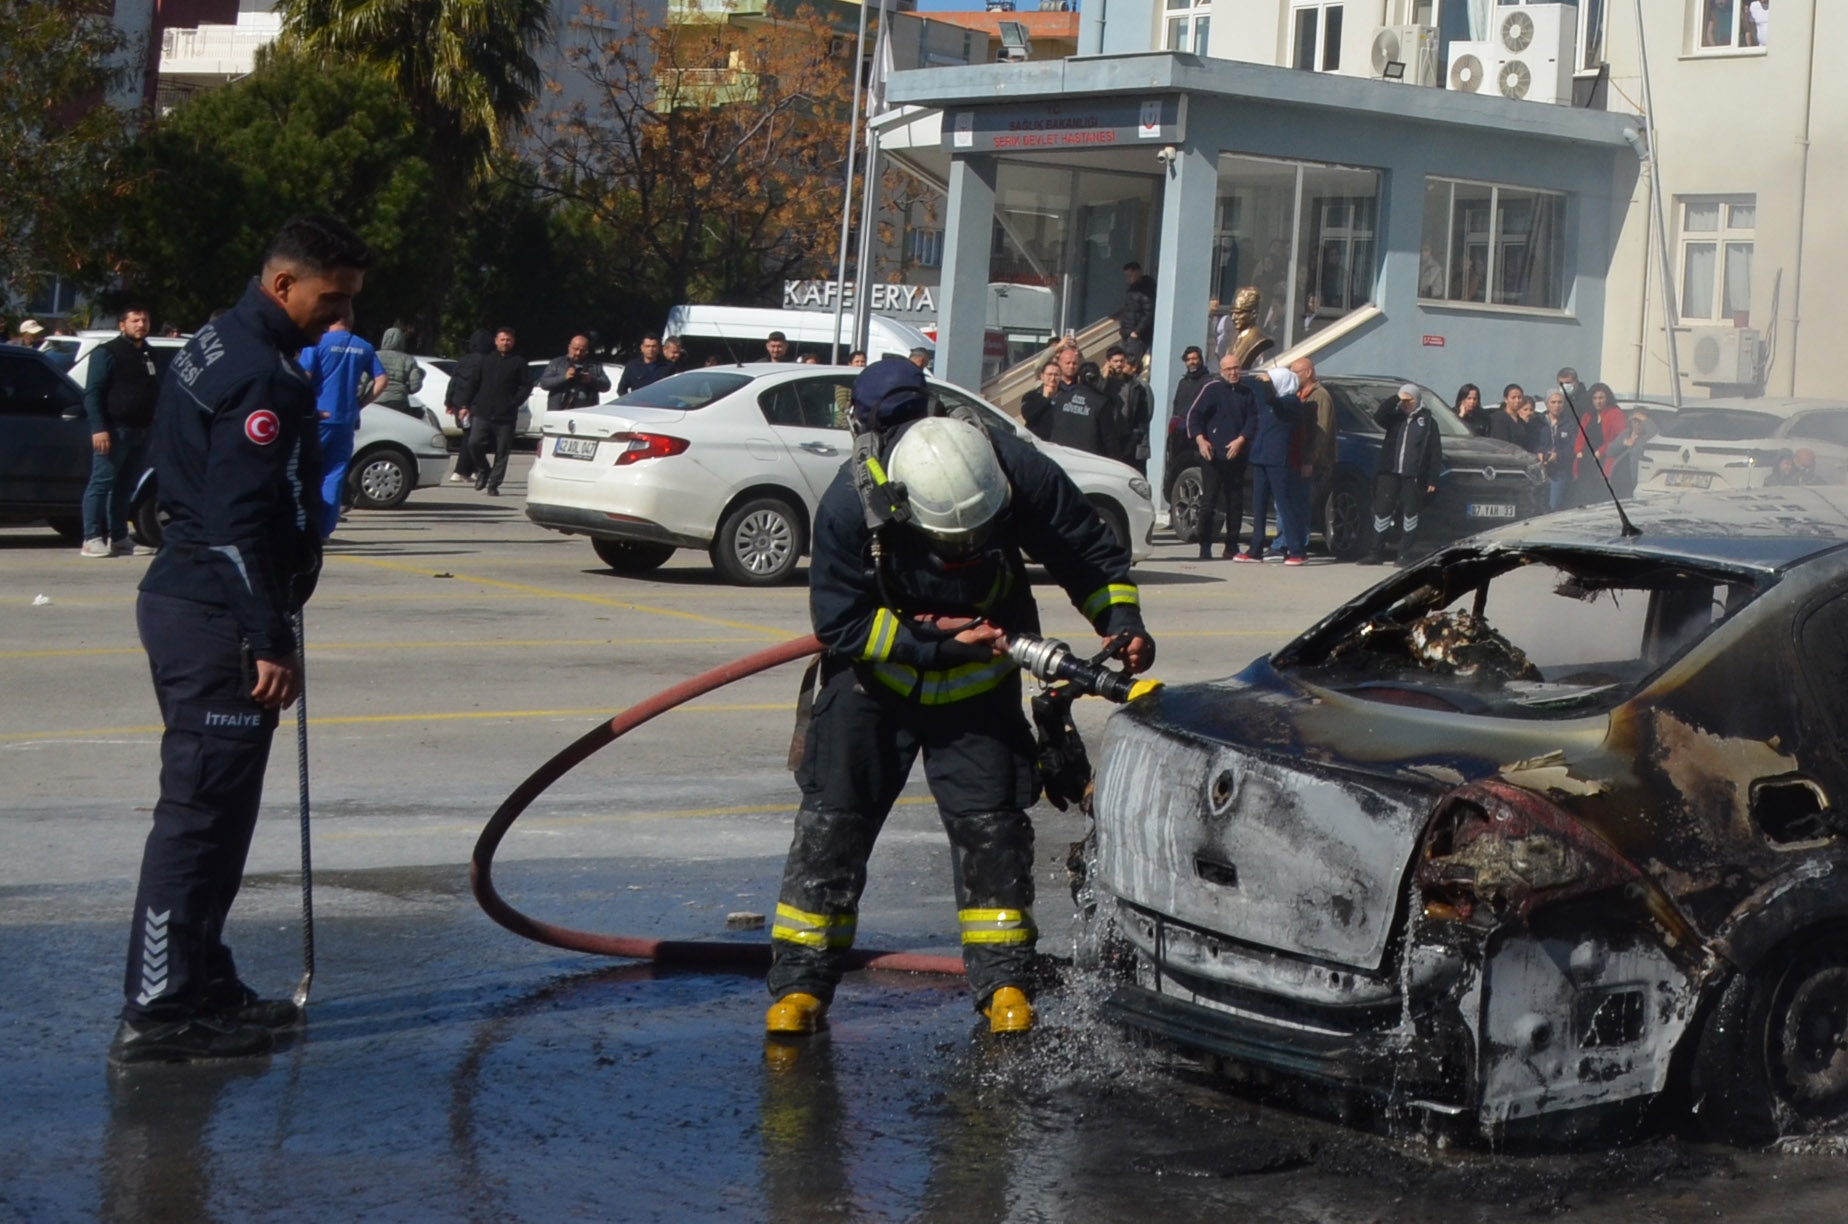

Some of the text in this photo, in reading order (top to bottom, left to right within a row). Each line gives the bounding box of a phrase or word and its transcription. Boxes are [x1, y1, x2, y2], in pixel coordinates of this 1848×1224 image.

[1023, 133, 1058, 146] DEVLET
[784, 278, 937, 312] KAFEERYA
[204, 711, 261, 726] İTFAİYE
